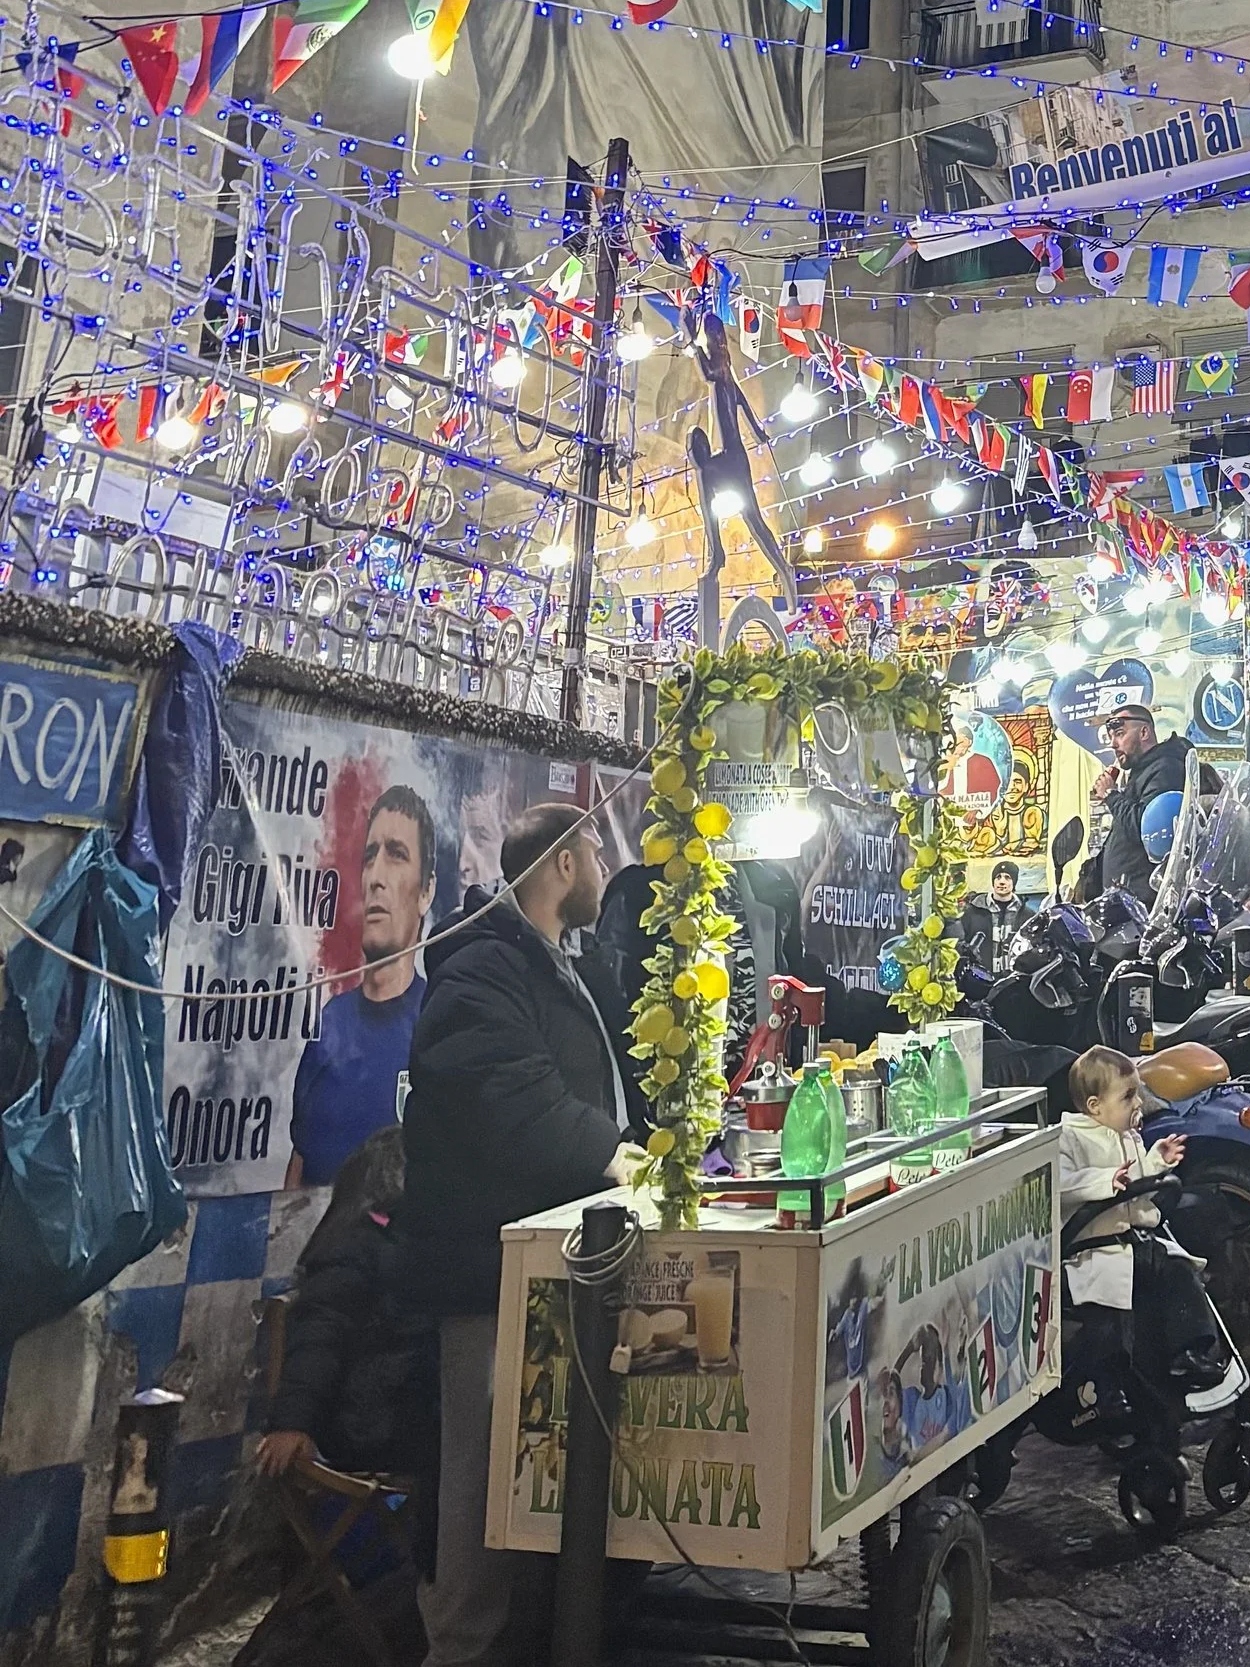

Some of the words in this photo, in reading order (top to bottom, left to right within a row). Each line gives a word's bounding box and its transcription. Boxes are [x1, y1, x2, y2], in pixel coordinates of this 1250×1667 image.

[1010, 108, 1199, 200] Benvenuti
[1204, 98, 1242, 156] al
[193, 842, 269, 936] Gigi
[273, 853, 341, 930] Riva
[811, 885, 897, 931] SCHILLACI
[177, 965, 298, 1052] Napoli
[301, 965, 325, 1042] ti
[168, 1085, 273, 1170] Onora
[899, 1237, 923, 1304] LA
[927, 1212, 974, 1288] VERA
[1031, 1291, 1042, 1344] 3
[628, 1369, 750, 1433] VERA
[977, 1350, 989, 1396] 2
[844, 1419, 854, 1466] 1
[529, 1450, 761, 1529] LIONATA
